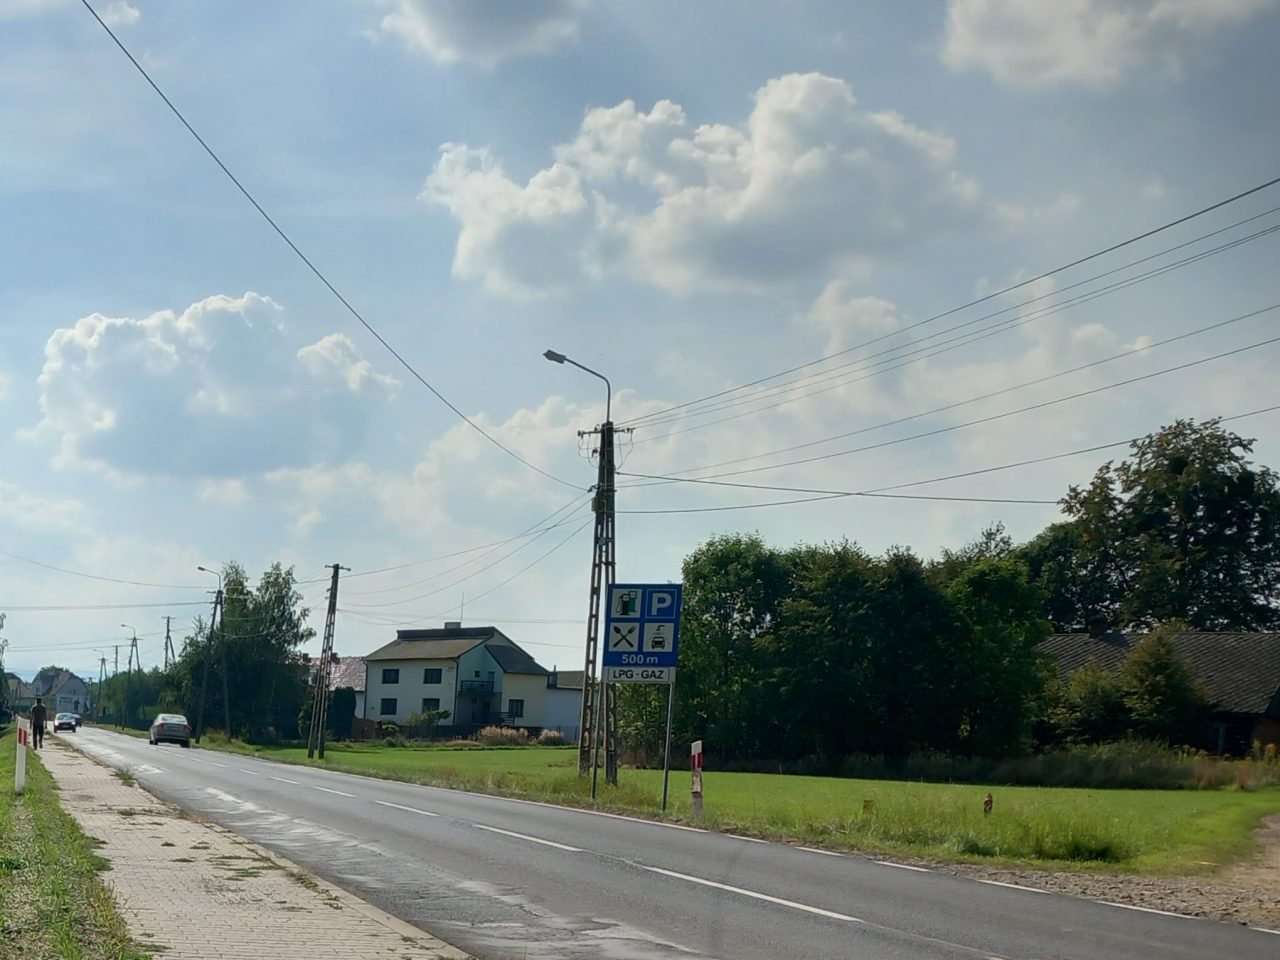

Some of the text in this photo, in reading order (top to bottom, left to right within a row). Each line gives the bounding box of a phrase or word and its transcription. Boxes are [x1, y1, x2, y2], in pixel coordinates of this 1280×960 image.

[651, 592, 672, 615] P
[621, 654, 659, 664] 500 m
[613, 669, 634, 679] LPG
[641, 669, 664, 679] GAZ
